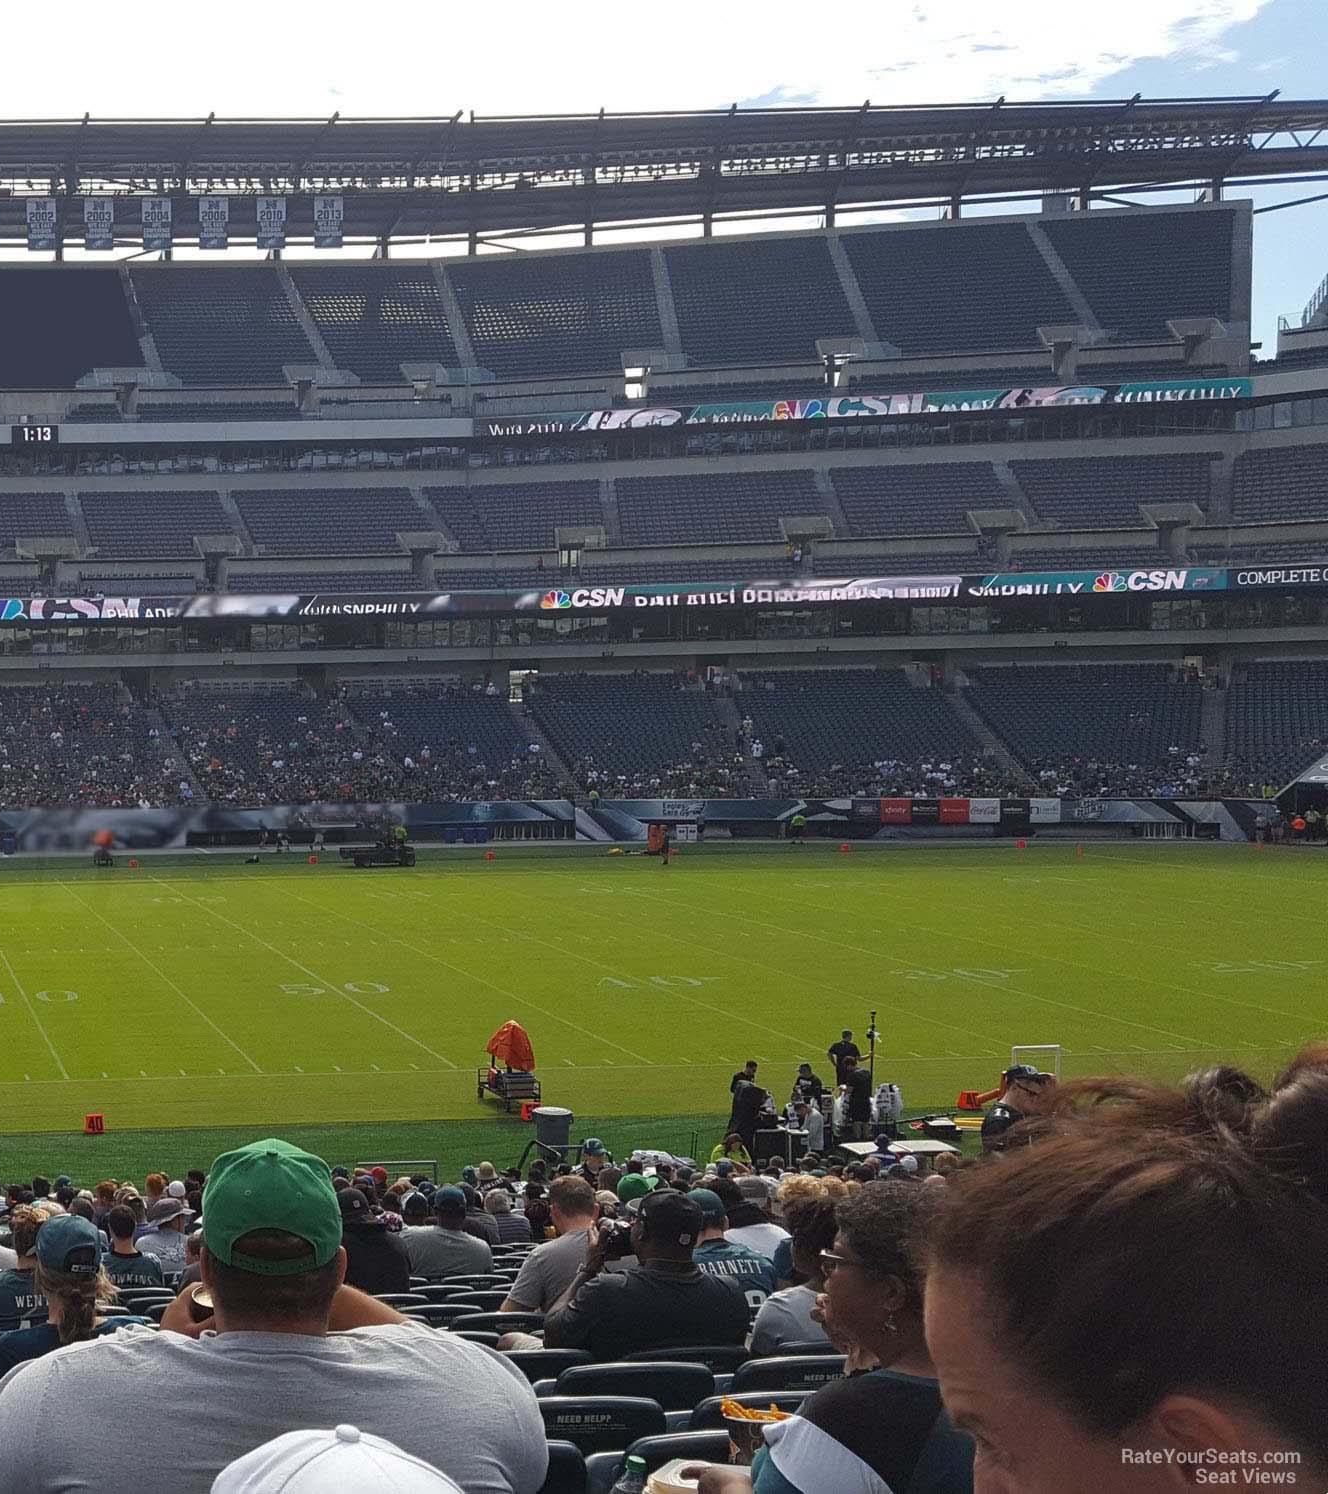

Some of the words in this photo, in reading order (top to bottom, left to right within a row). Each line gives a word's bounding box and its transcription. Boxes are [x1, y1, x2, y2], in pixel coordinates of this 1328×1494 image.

[29, 212, 54, 222] 2002
[86, 212, 111, 222] 2003
[144, 211, 169, 221] 2004
[260, 211, 282, 221] 2010
[317, 210, 341, 220] 2013
[23, 427, 51, 440] 1:13
[1128, 571, 1187, 591] CSN
[1237, 569, 1320, 584] COMPLETE
[572, 589, 624, 607] CSN
[88, 1116, 103, 1134] 40
[697, 1259, 762, 1275] BARNETT
[557, 1415, 581, 1423] NEED
[584, 1415, 611, 1423] HELP?
